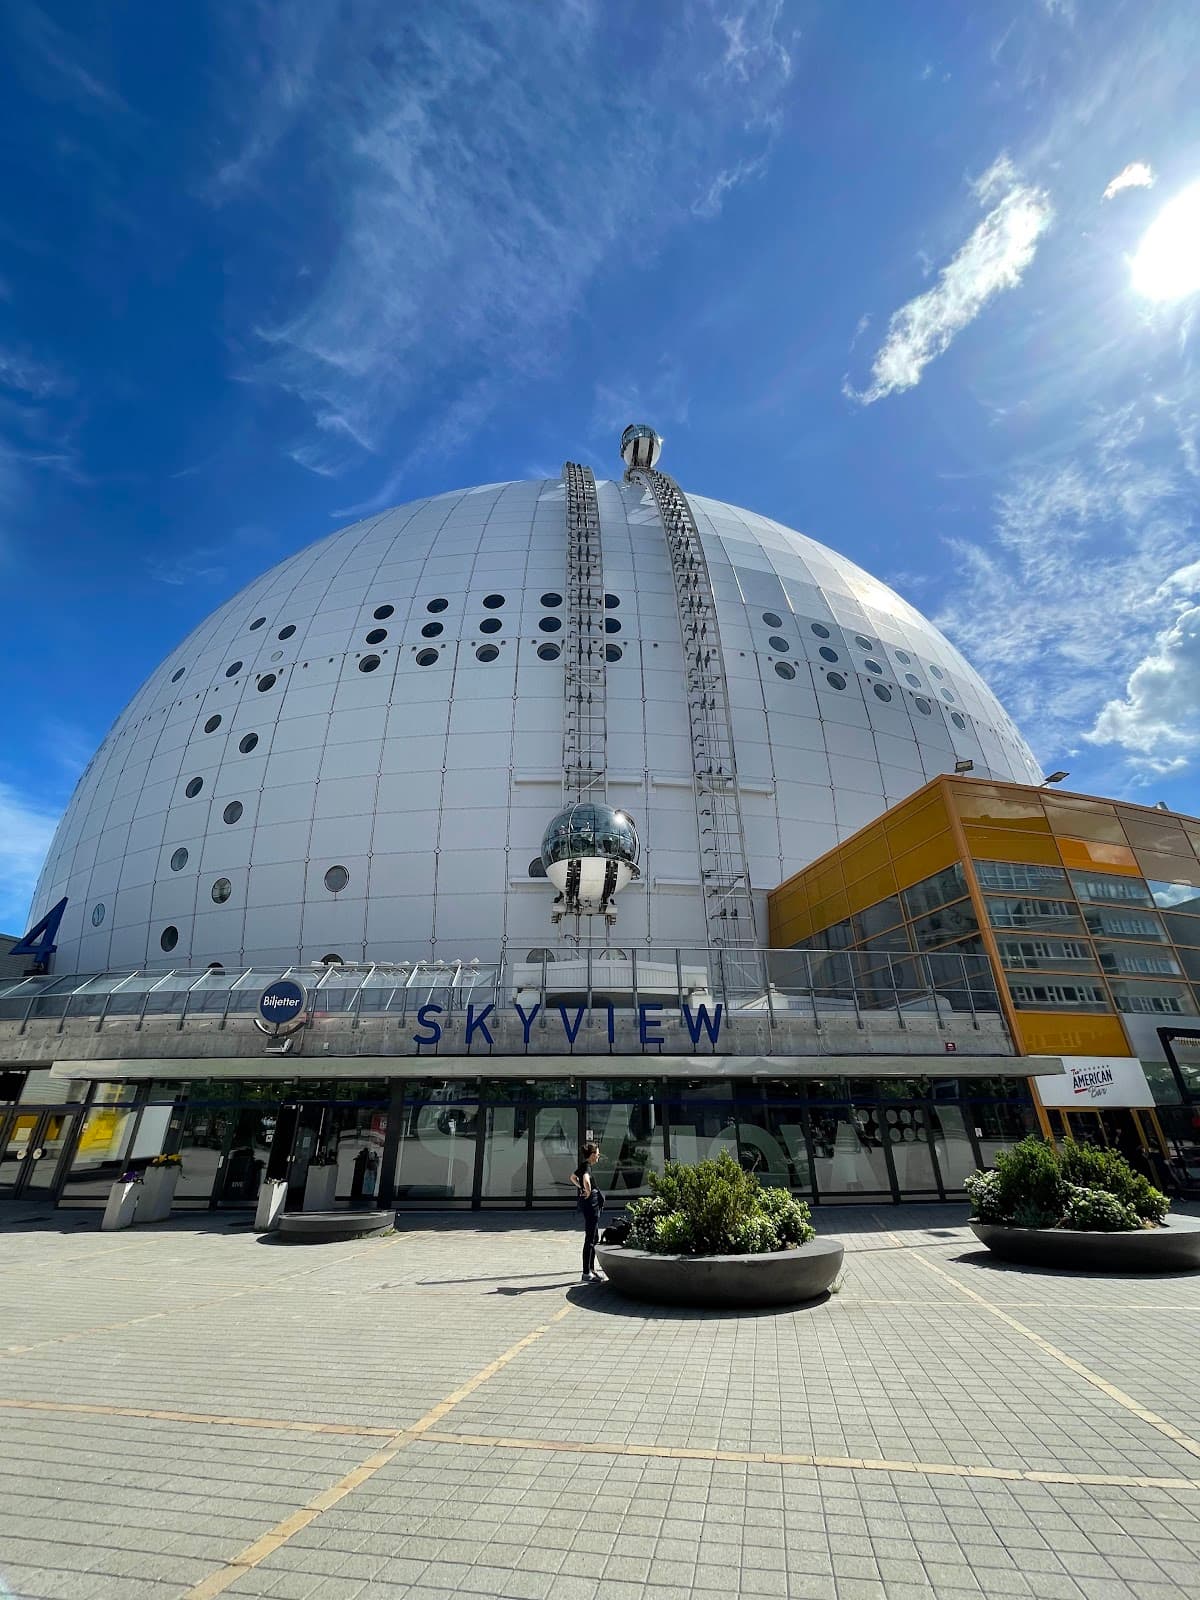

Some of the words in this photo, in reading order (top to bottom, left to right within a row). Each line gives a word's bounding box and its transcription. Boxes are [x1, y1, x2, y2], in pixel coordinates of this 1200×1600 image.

[8, 896, 69, 963] 4
[263, 994, 300, 1009] Biljetter
[412, 1003, 723, 1045] SKYVIEW
[1073, 1069, 1113, 1089] AMERICAN
